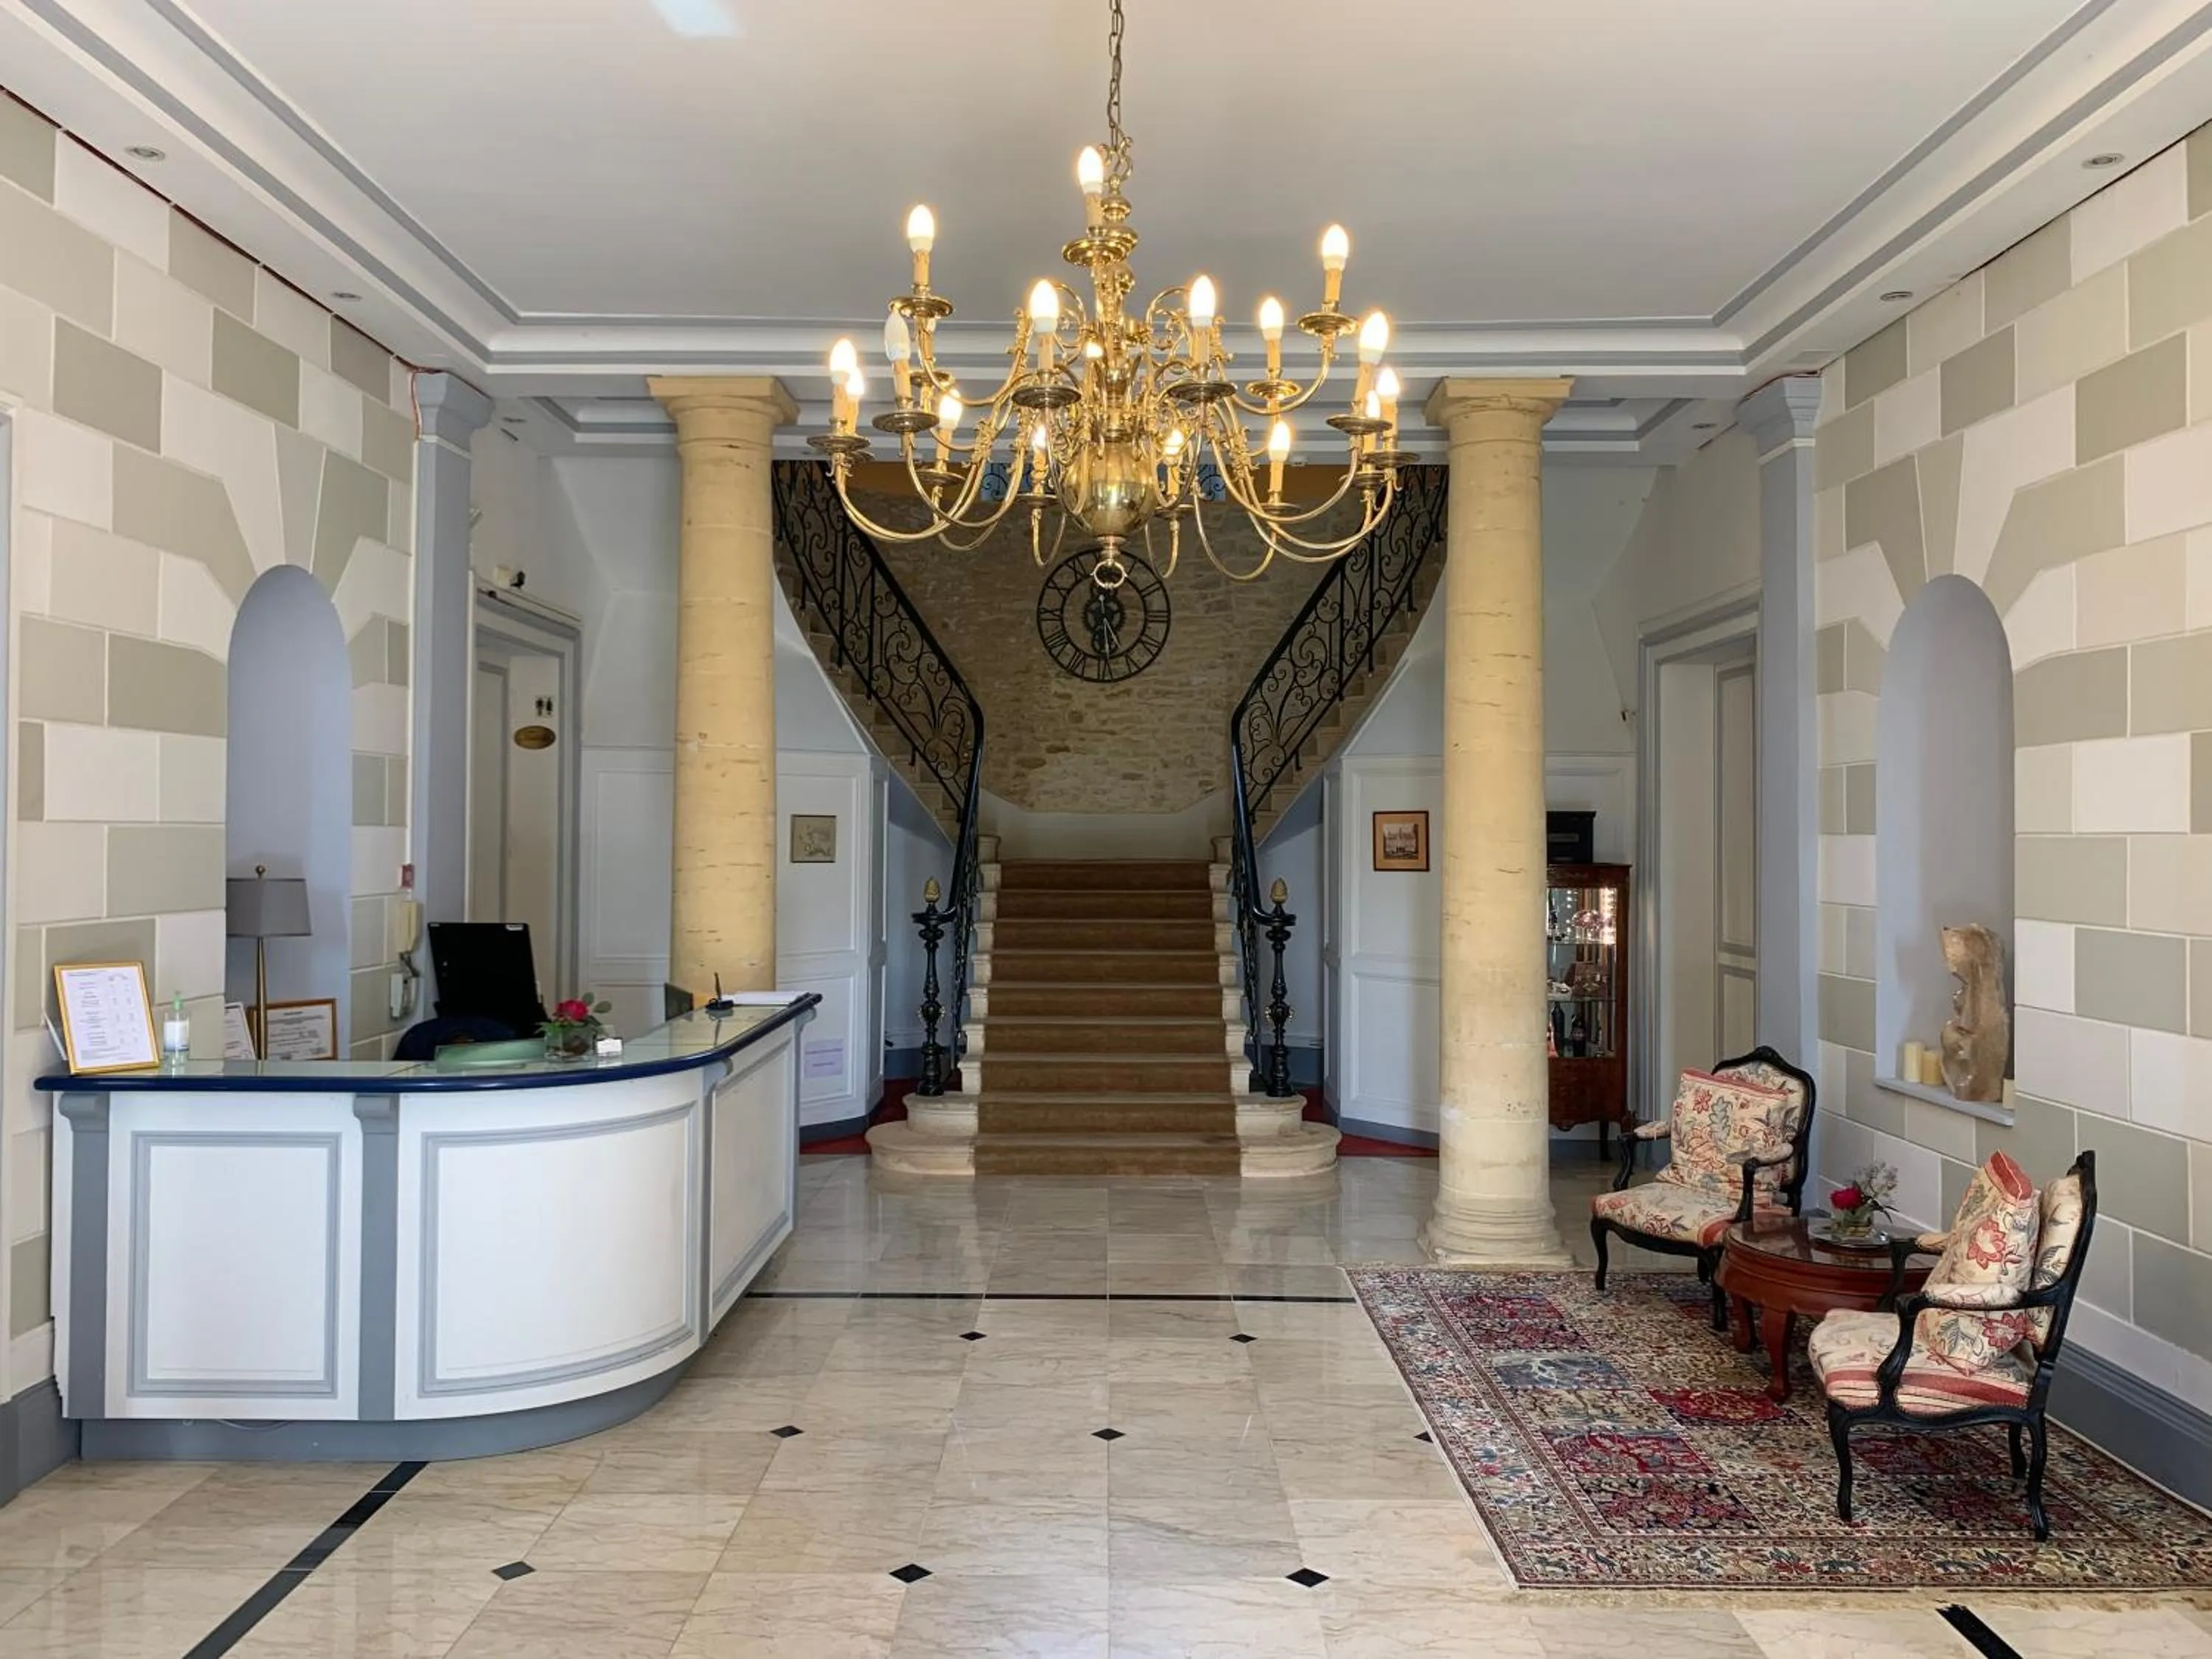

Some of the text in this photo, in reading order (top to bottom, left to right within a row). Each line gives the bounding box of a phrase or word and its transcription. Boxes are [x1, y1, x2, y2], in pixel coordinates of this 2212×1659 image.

[1139, 581, 1161, 598] II
[1146, 609, 1169, 624] III
[1124, 653, 1141, 672] V
